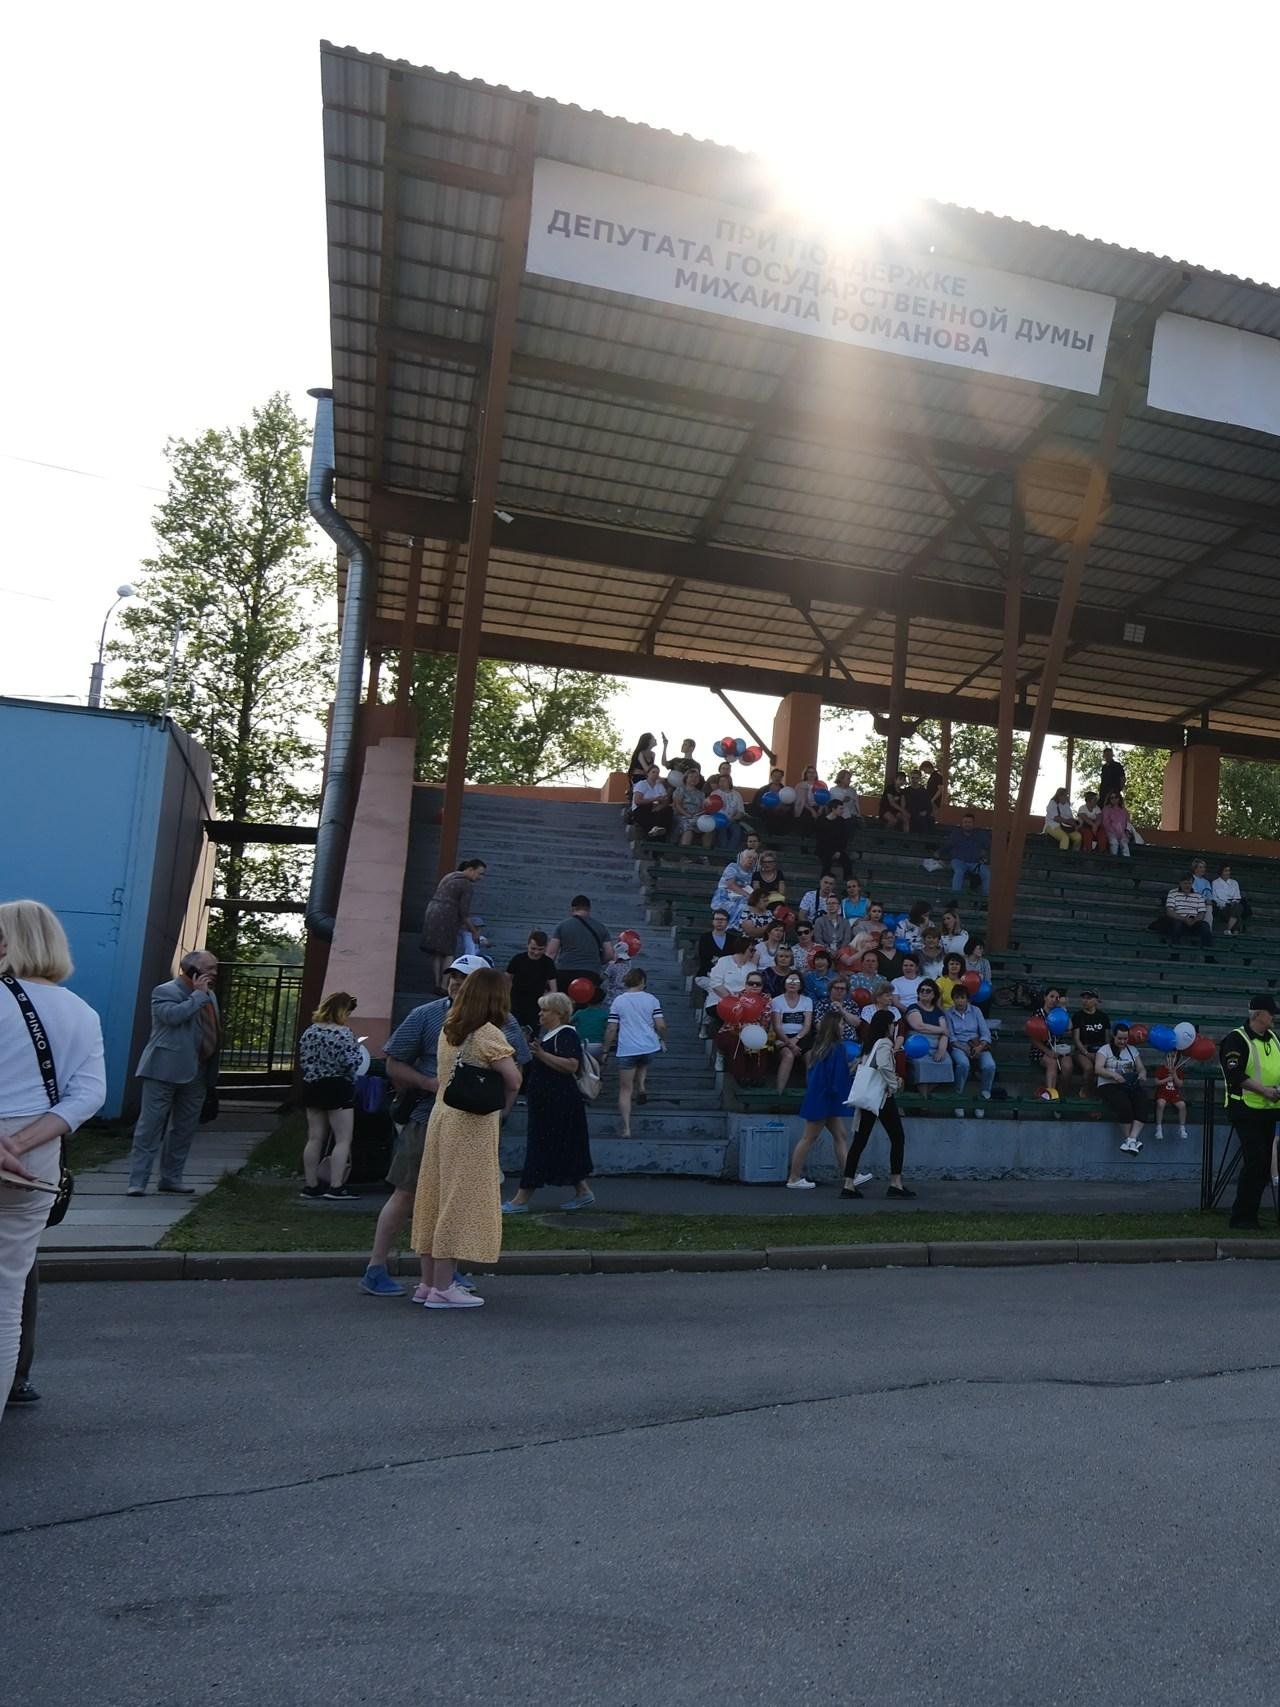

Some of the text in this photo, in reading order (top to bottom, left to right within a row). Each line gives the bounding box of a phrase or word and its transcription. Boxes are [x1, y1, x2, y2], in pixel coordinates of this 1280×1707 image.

[715, 218, 778, 253] ПРИ
[547, 209, 1095, 352] ДЕПУТАТА ГОСУДАРСТВЕННОЙ ДУМЫ
[675, 268, 989, 357] МИХАИЛА РОМАНОВА
[25, 1011, 47, 1050] PINKO
